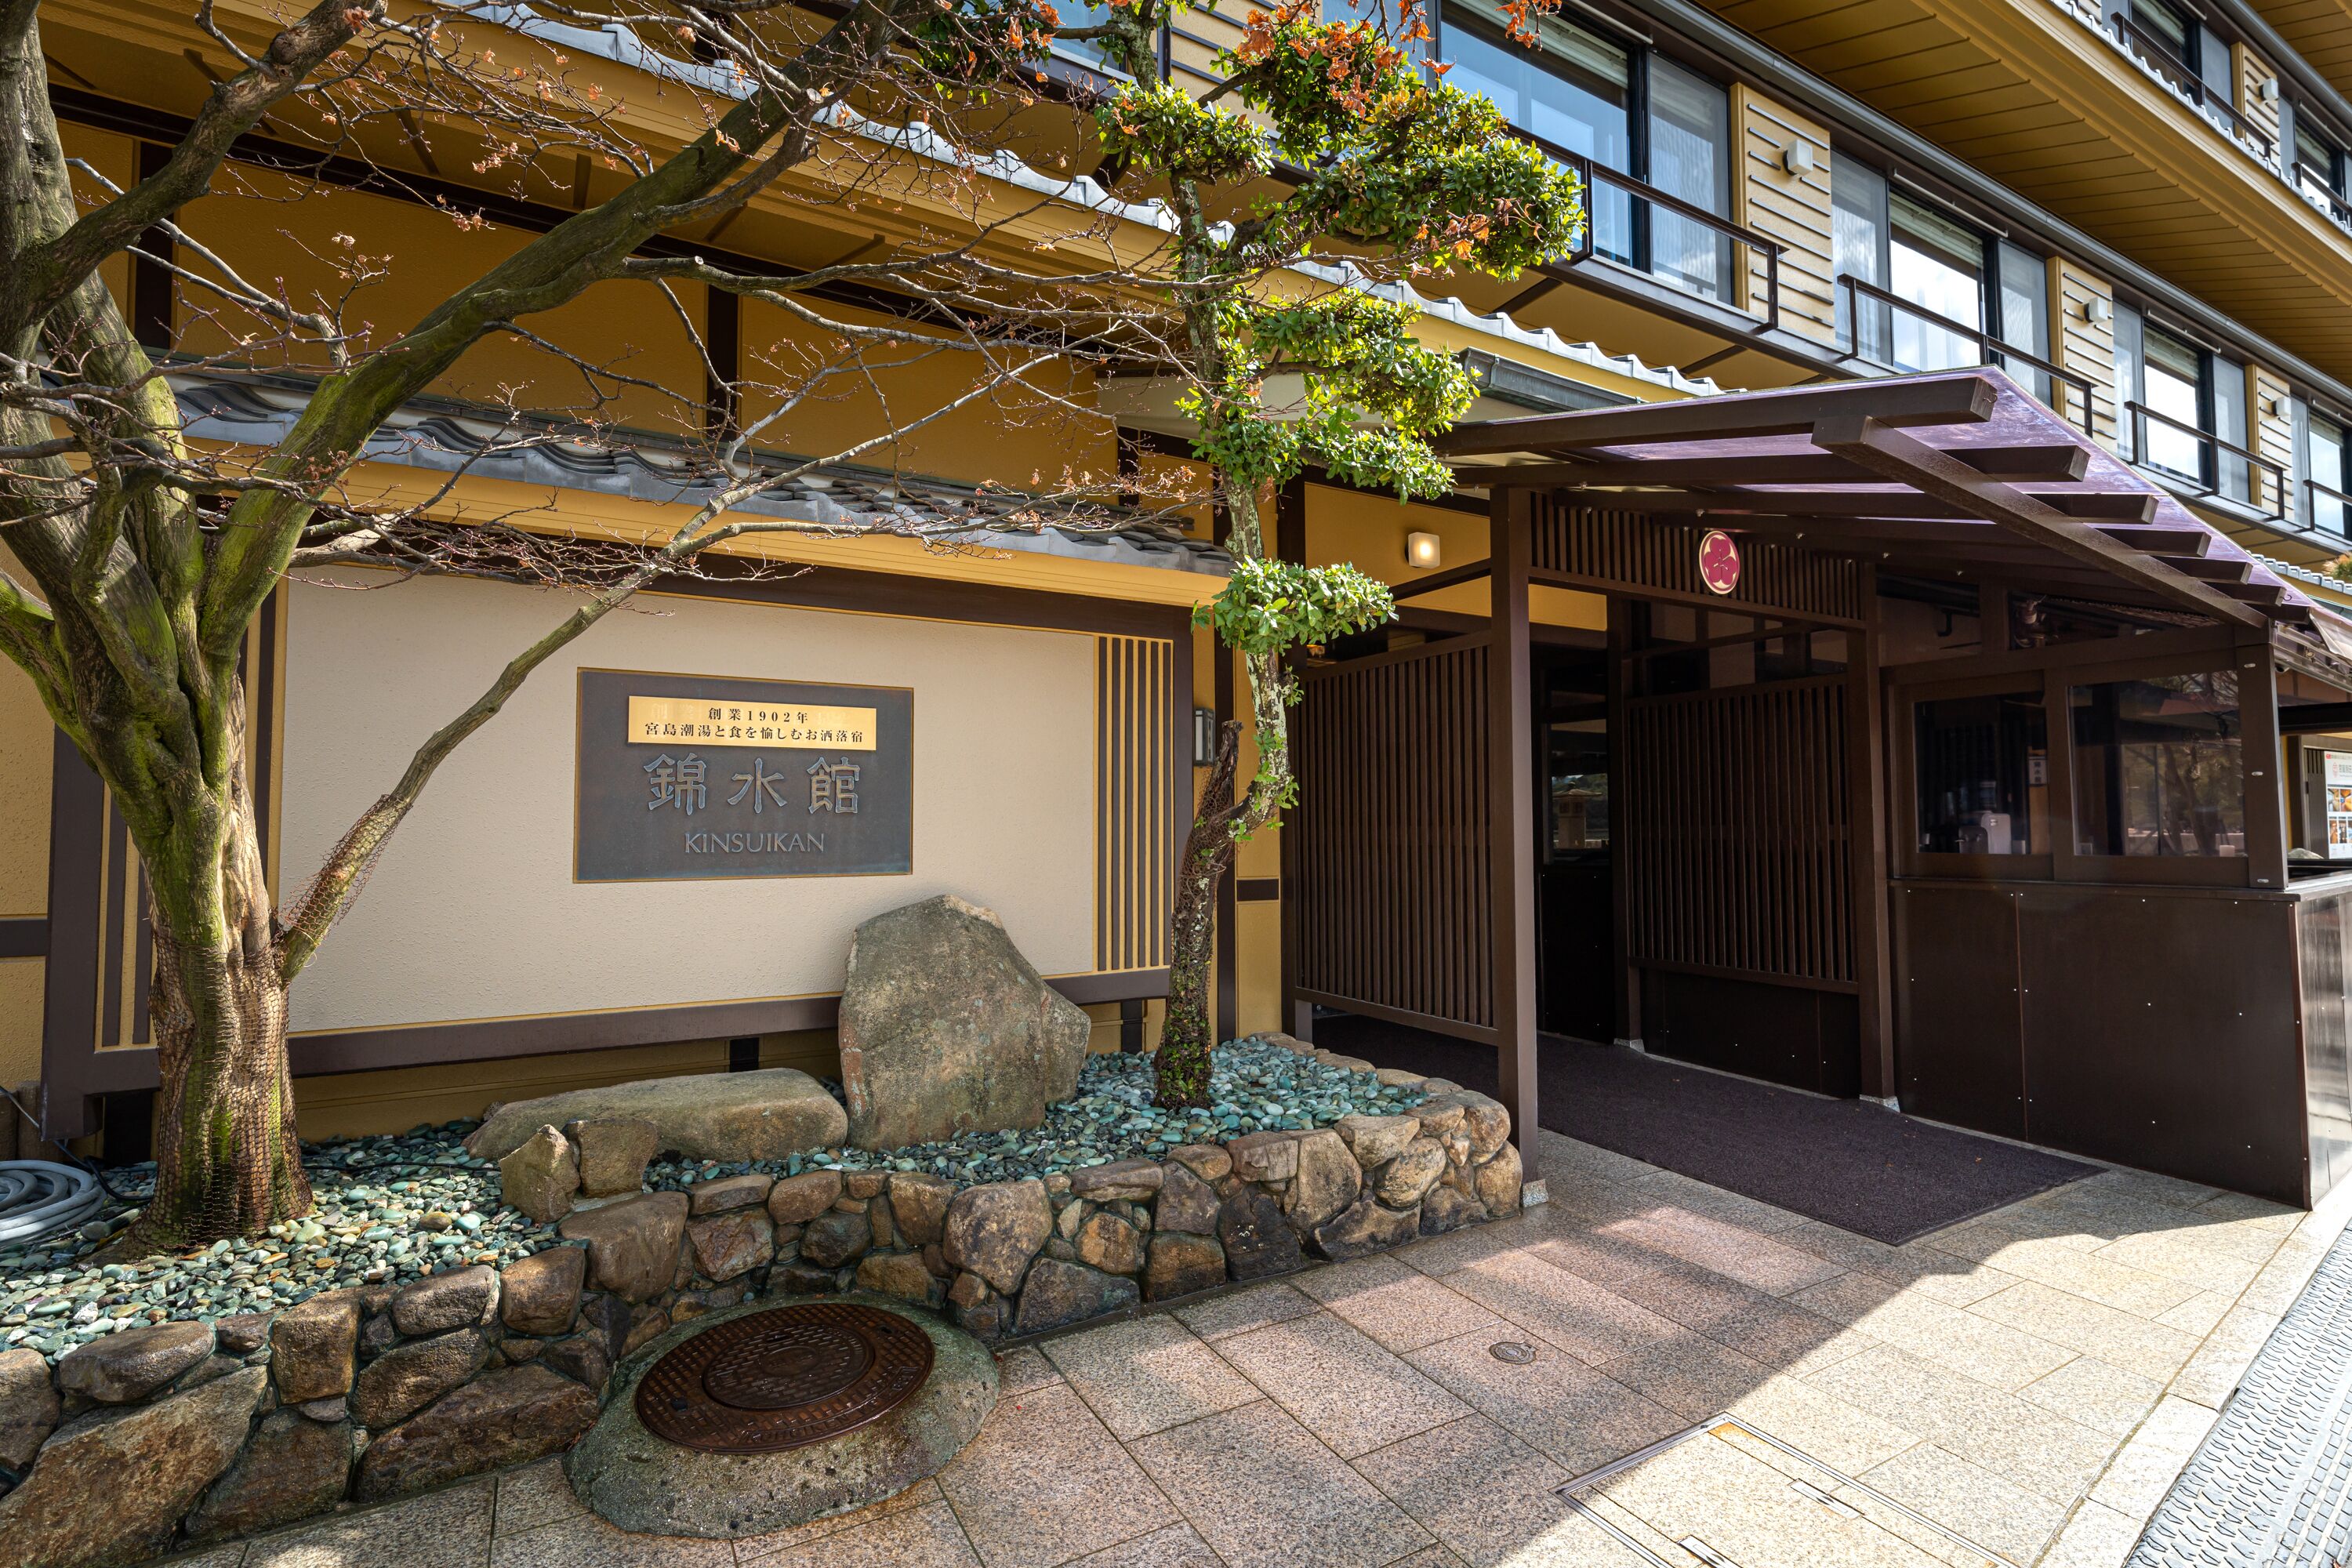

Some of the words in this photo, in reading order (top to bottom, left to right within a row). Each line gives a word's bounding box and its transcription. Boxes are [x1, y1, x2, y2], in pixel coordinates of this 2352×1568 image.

[708, 707, 808, 724] 創業1902年
[644, 722, 863, 743] 宮島潮湯と食を愉しむお洒落宿
[643, 753, 861, 815] 錦水館
[684, 832, 824, 854] KINSUIKAN
